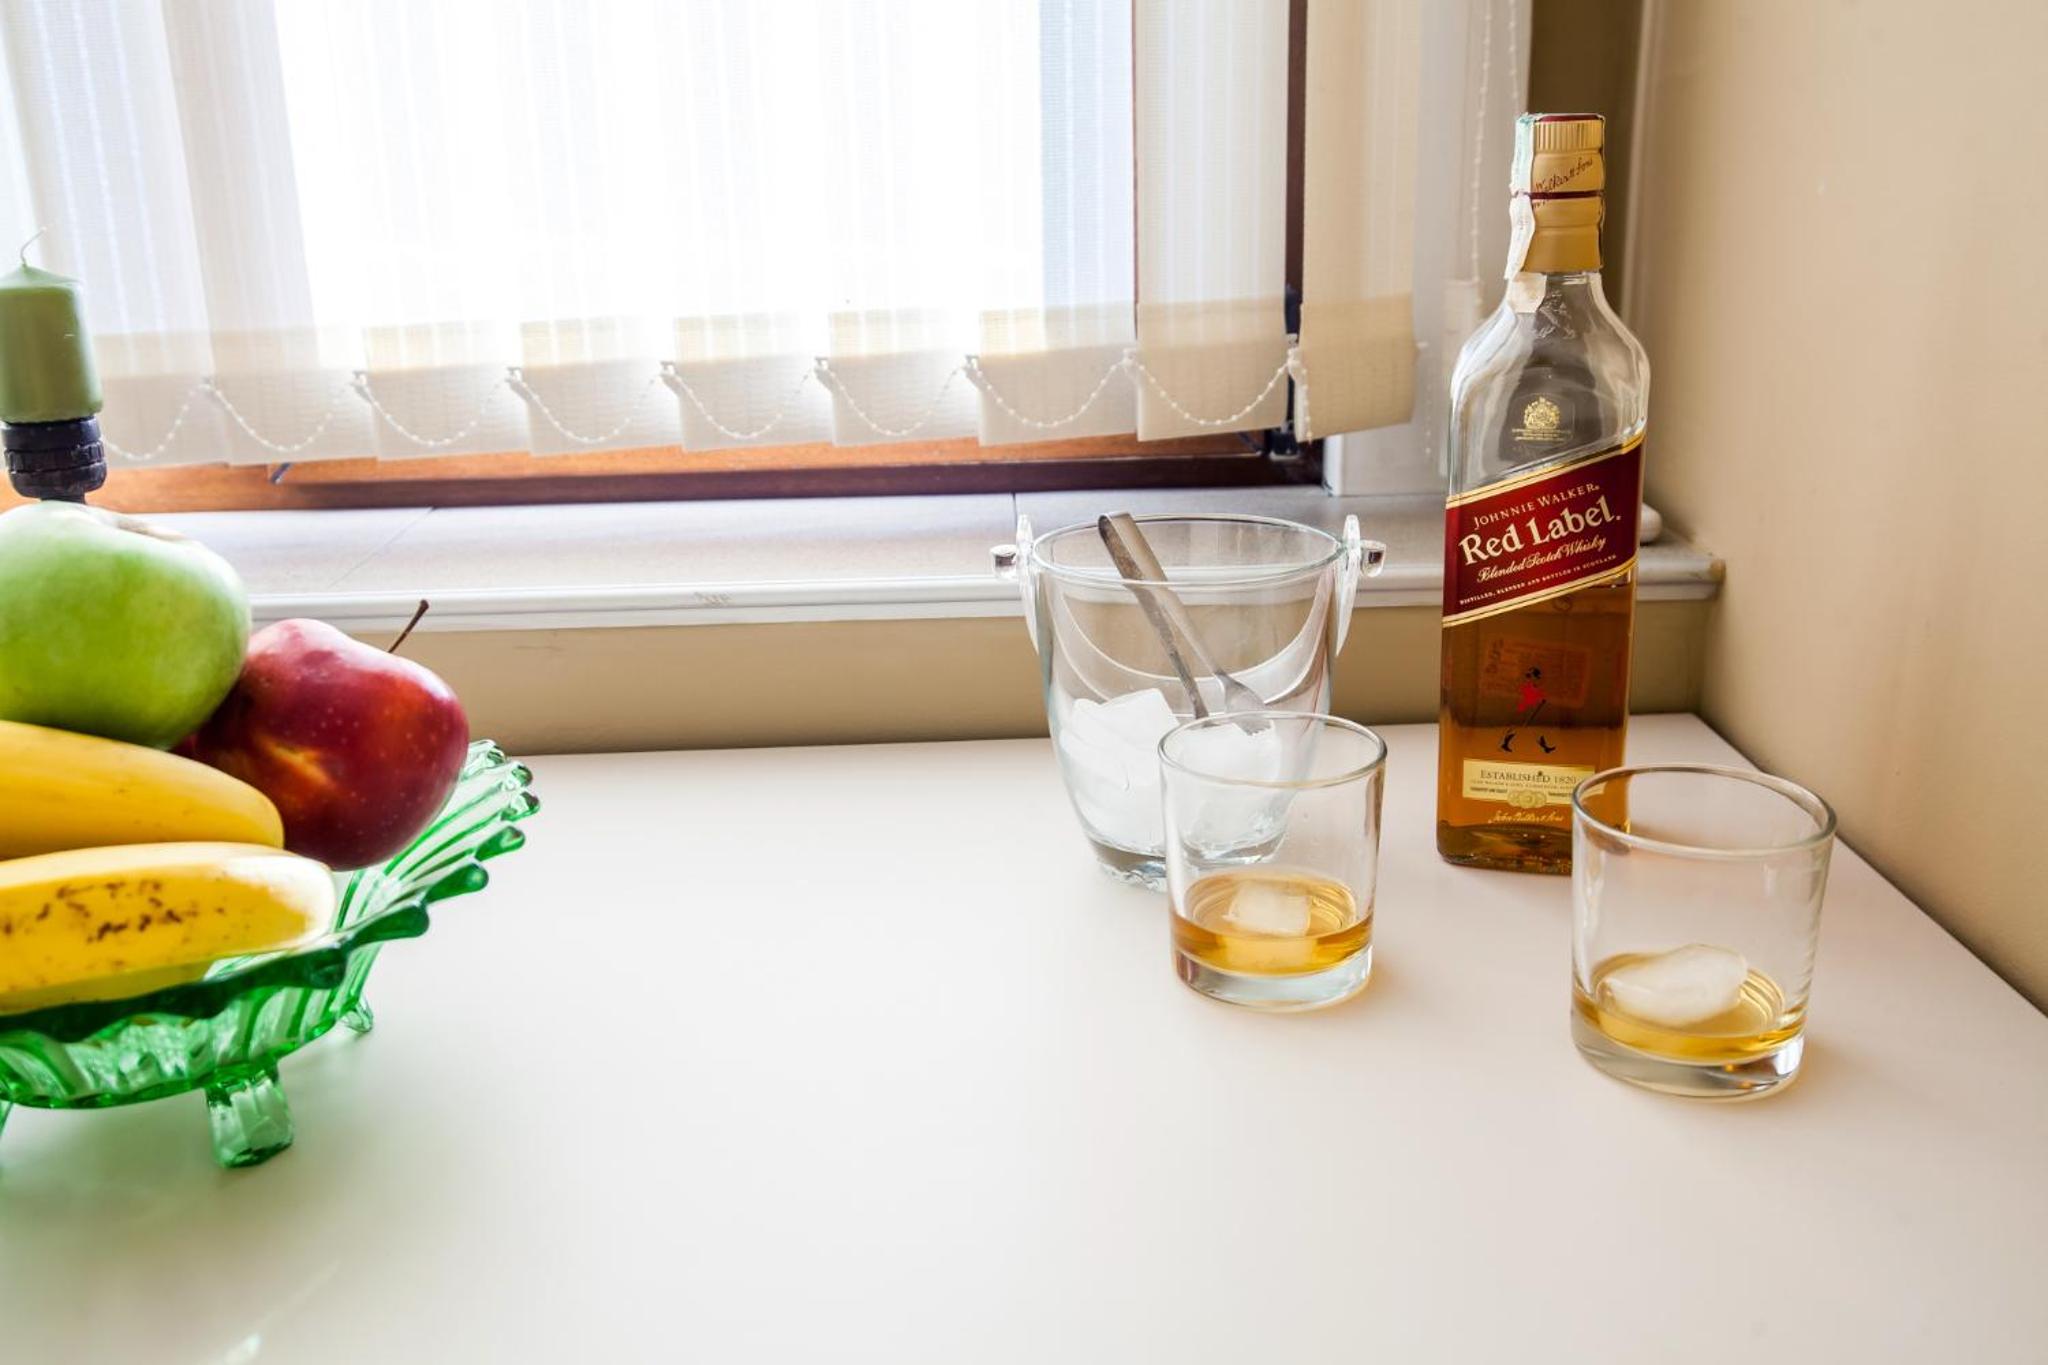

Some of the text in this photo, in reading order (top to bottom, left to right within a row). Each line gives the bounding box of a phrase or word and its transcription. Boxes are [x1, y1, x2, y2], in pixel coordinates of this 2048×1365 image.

[1473, 502, 1536, 530] JOHNNIE
[1458, 522, 1525, 566] Red
[1476, 533, 1607, 583] Blended Scotch Whisky
[1480, 769, 1551, 783] ESTABLISHED
